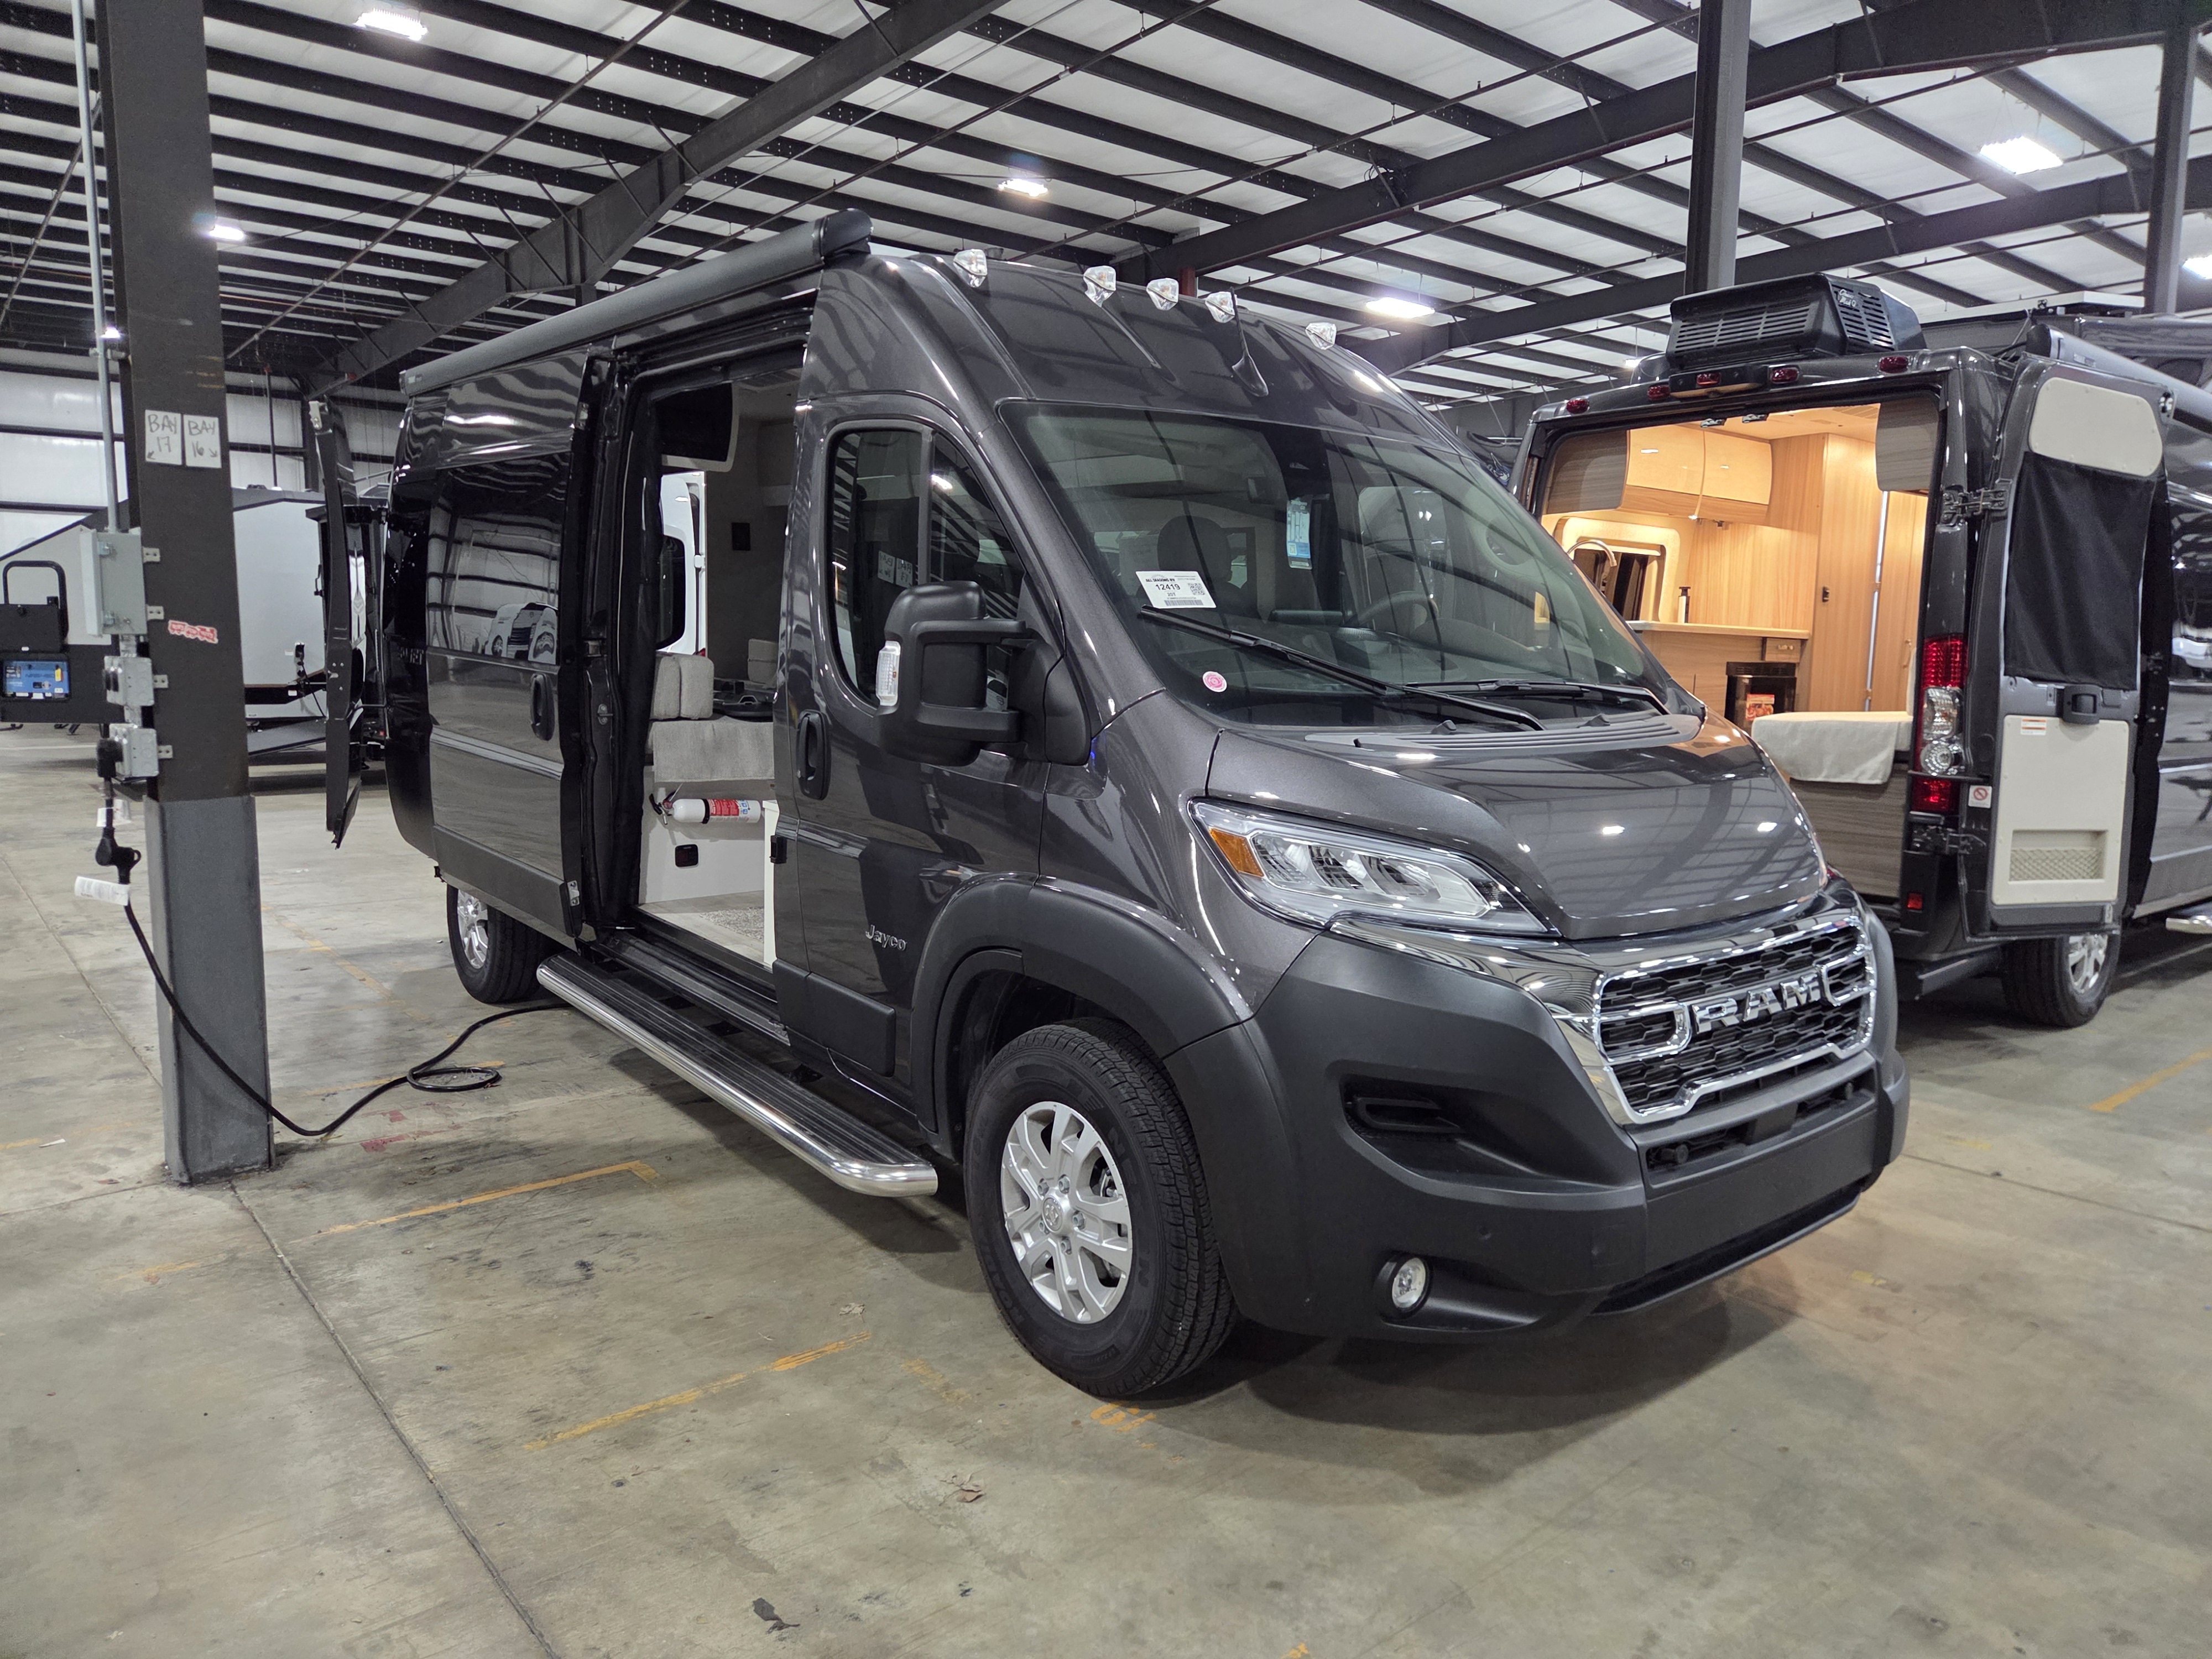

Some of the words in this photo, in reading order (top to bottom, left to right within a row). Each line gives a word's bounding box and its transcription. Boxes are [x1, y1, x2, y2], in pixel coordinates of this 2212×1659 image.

[148, 414, 177, 434] BAY
[188, 420, 215, 436] BAY
[157, 436, 171, 452] 17
[192, 441, 204, 458] 16
[865, 925, 906, 951] Jayco
[1691, 973, 1821, 1034] RAM
